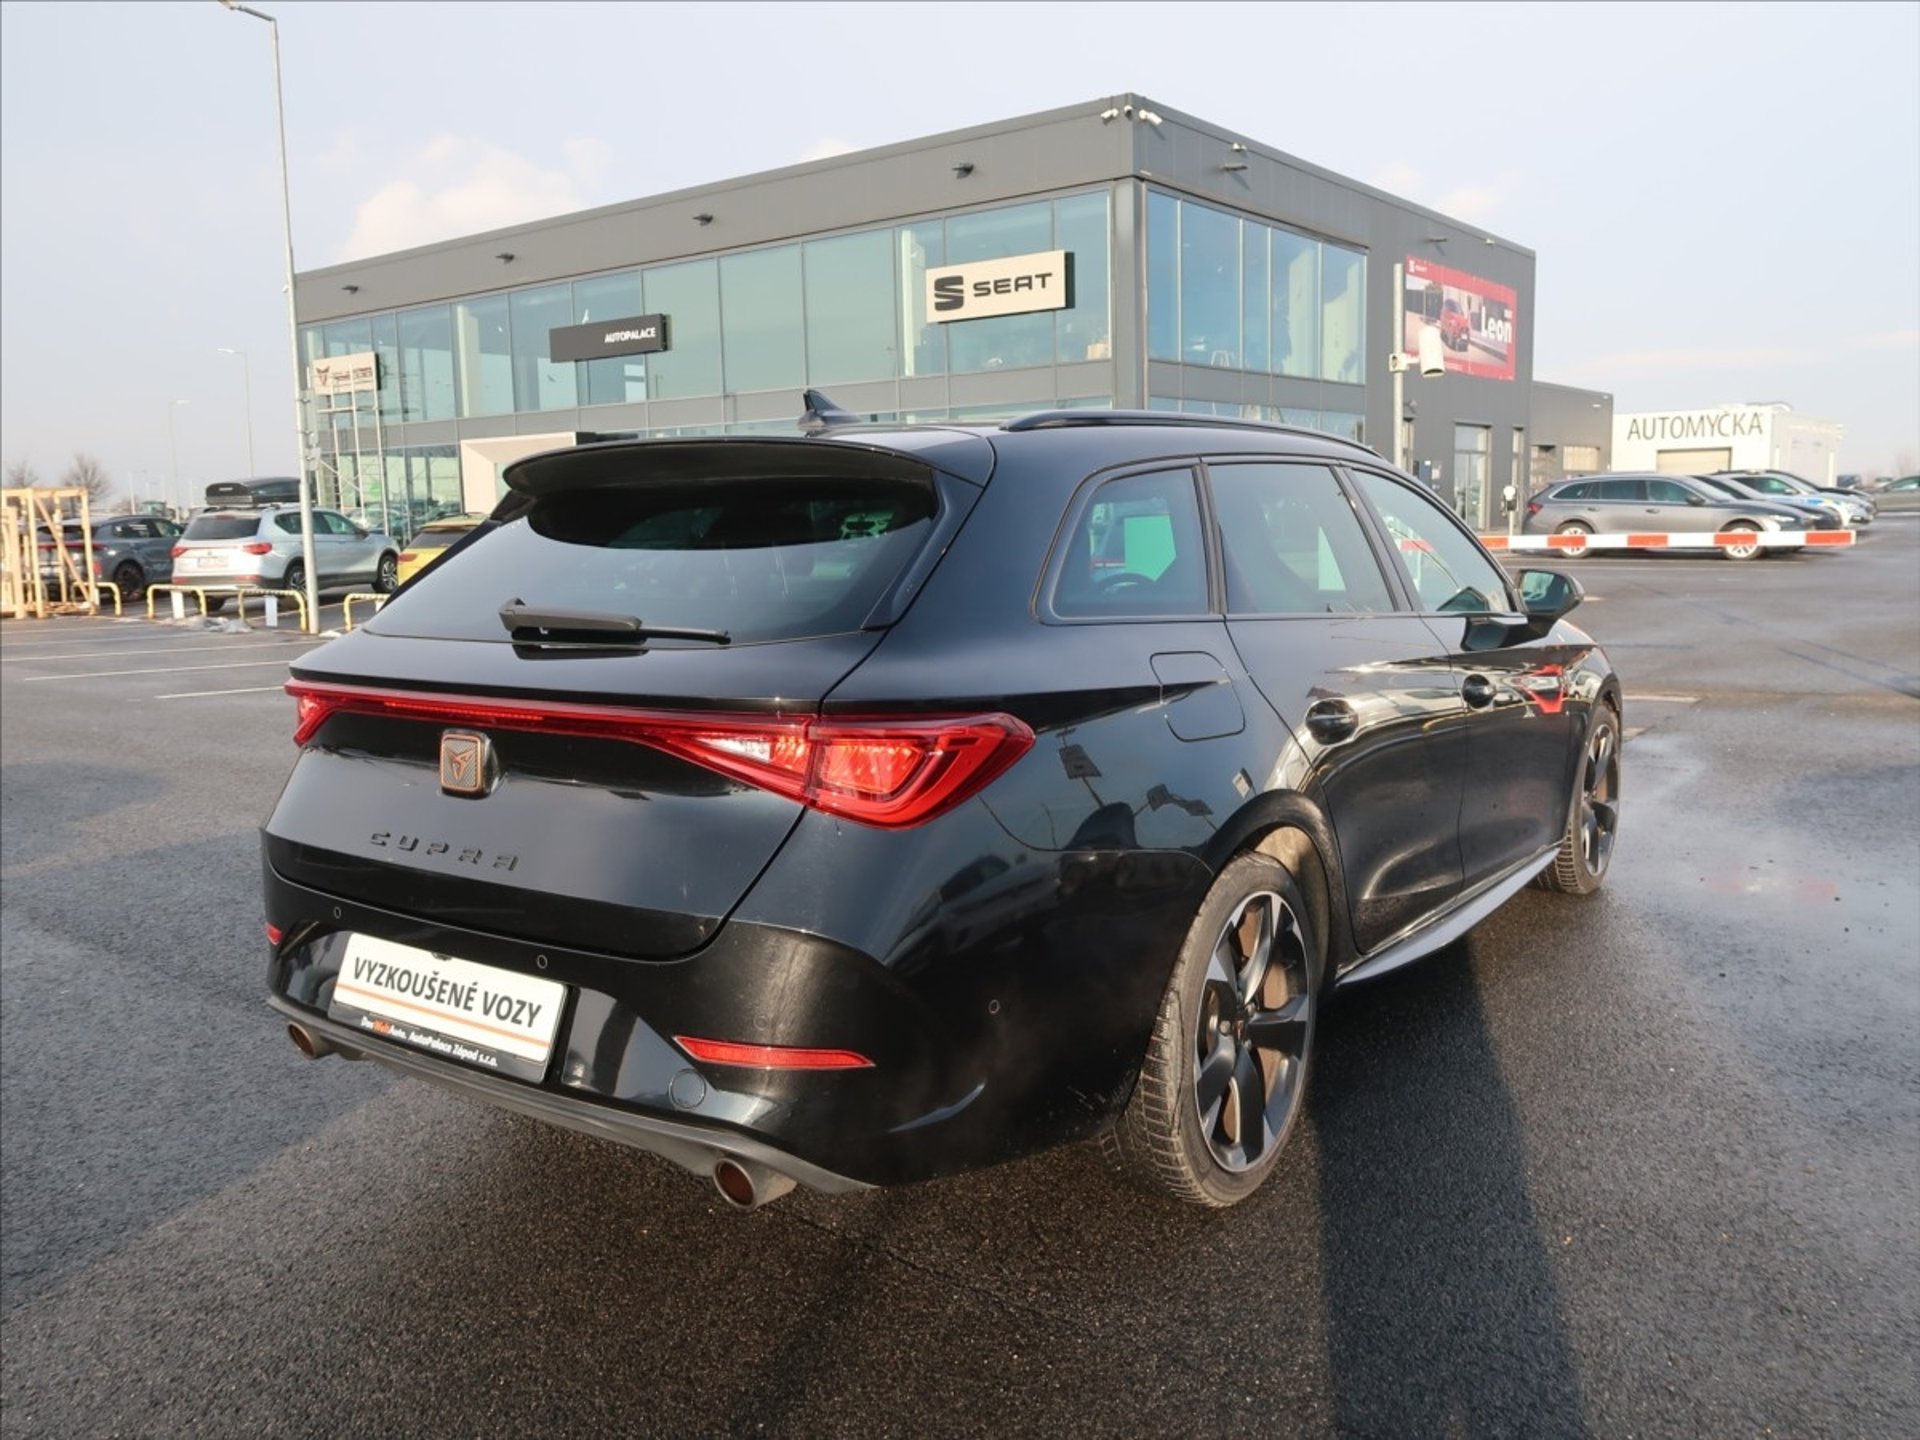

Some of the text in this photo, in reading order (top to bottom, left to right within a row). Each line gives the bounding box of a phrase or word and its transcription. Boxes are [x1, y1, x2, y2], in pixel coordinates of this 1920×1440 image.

[973, 272, 1053, 297] SEAT
[604, 327, 656, 343] AUTOPALACE
[1481, 306, 1513, 344] Leon
[1627, 411, 1763, 440] AUTOMYČKA
[370, 832, 519, 871] CUPRA
[353, 956, 542, 1028] VYZKOUŠENÉ VOZY
